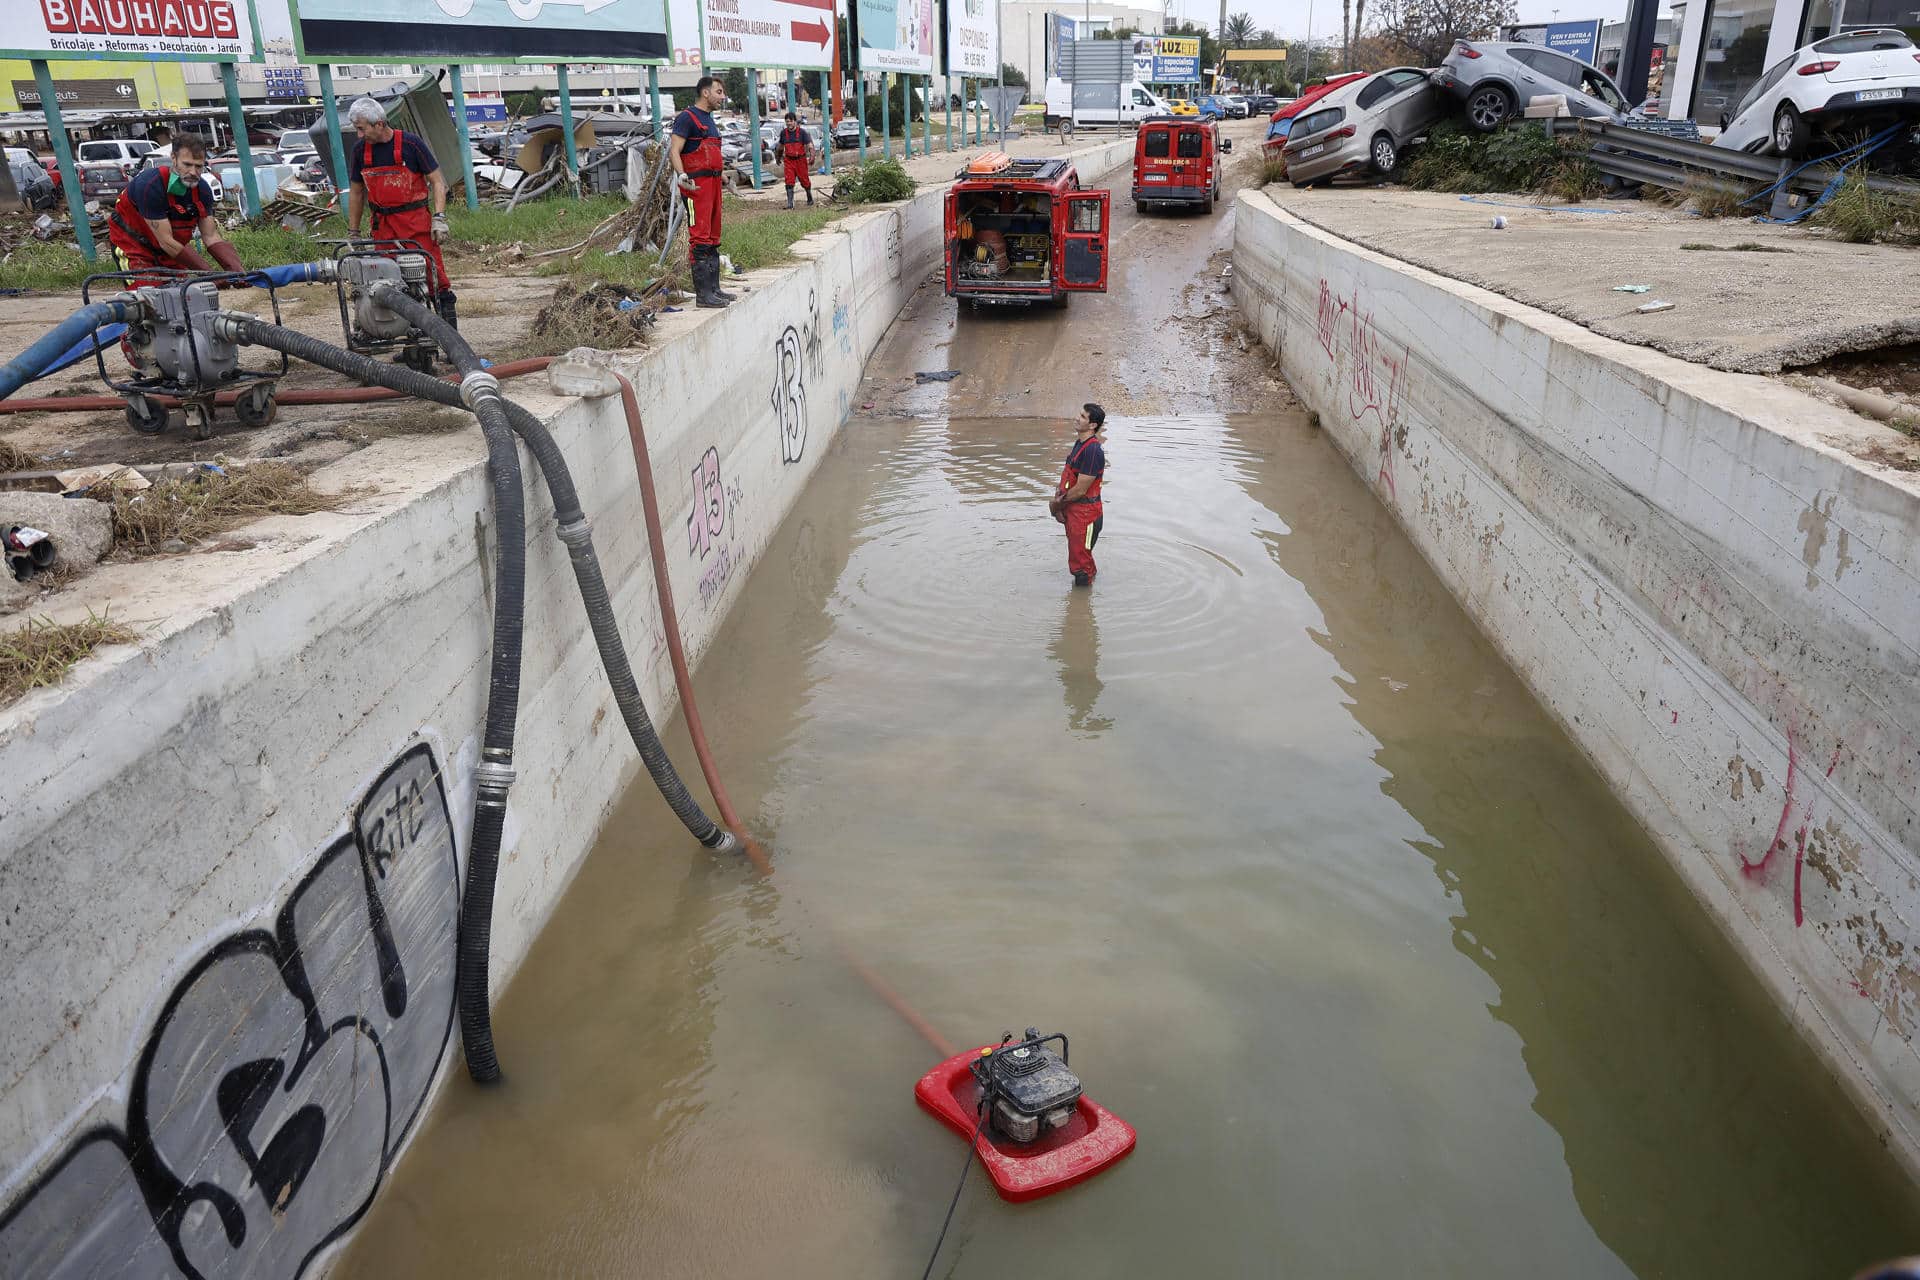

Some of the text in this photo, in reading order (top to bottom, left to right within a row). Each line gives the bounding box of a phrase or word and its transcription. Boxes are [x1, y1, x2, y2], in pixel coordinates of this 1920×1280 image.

[46, 0, 233, 32] BAUHAUS
[708, 16, 723, 32] ZONA
[723, 17, 751, 35] COMERCIAL
[51, 38, 242, 53] Bricolaje Reformas Decoración Jardín
[710, 35, 726, 51] JUNTO
[731, 37, 742, 52] IKEA
[960, 27, 989, 50] DISPONIBLE
[18, 91, 79, 102] Benguts
